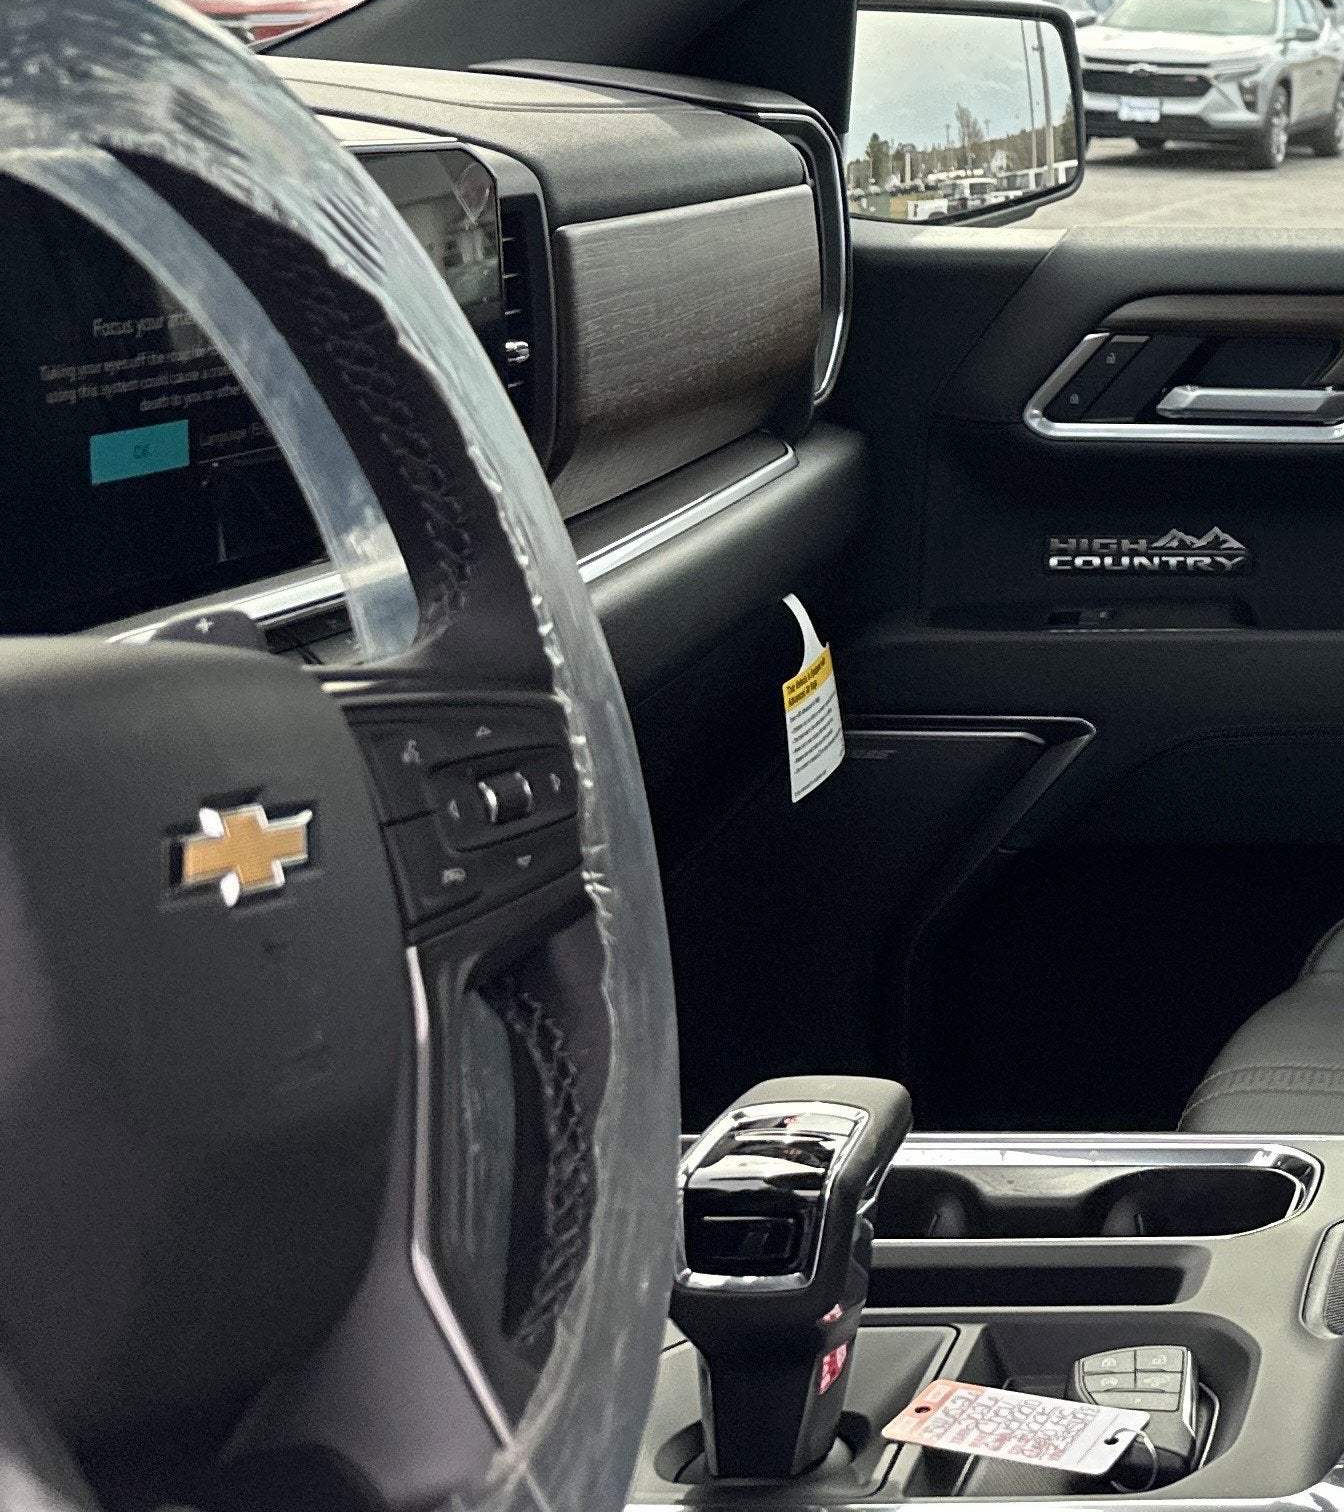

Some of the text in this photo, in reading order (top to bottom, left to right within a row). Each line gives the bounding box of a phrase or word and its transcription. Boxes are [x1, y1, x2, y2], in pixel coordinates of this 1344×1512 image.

[92, 317, 133, 337] Focus
[135, 314, 163, 336] your
[1050, 538, 1148, 553] HIGH
[1049, 555, 1245, 571] COUNTRY
